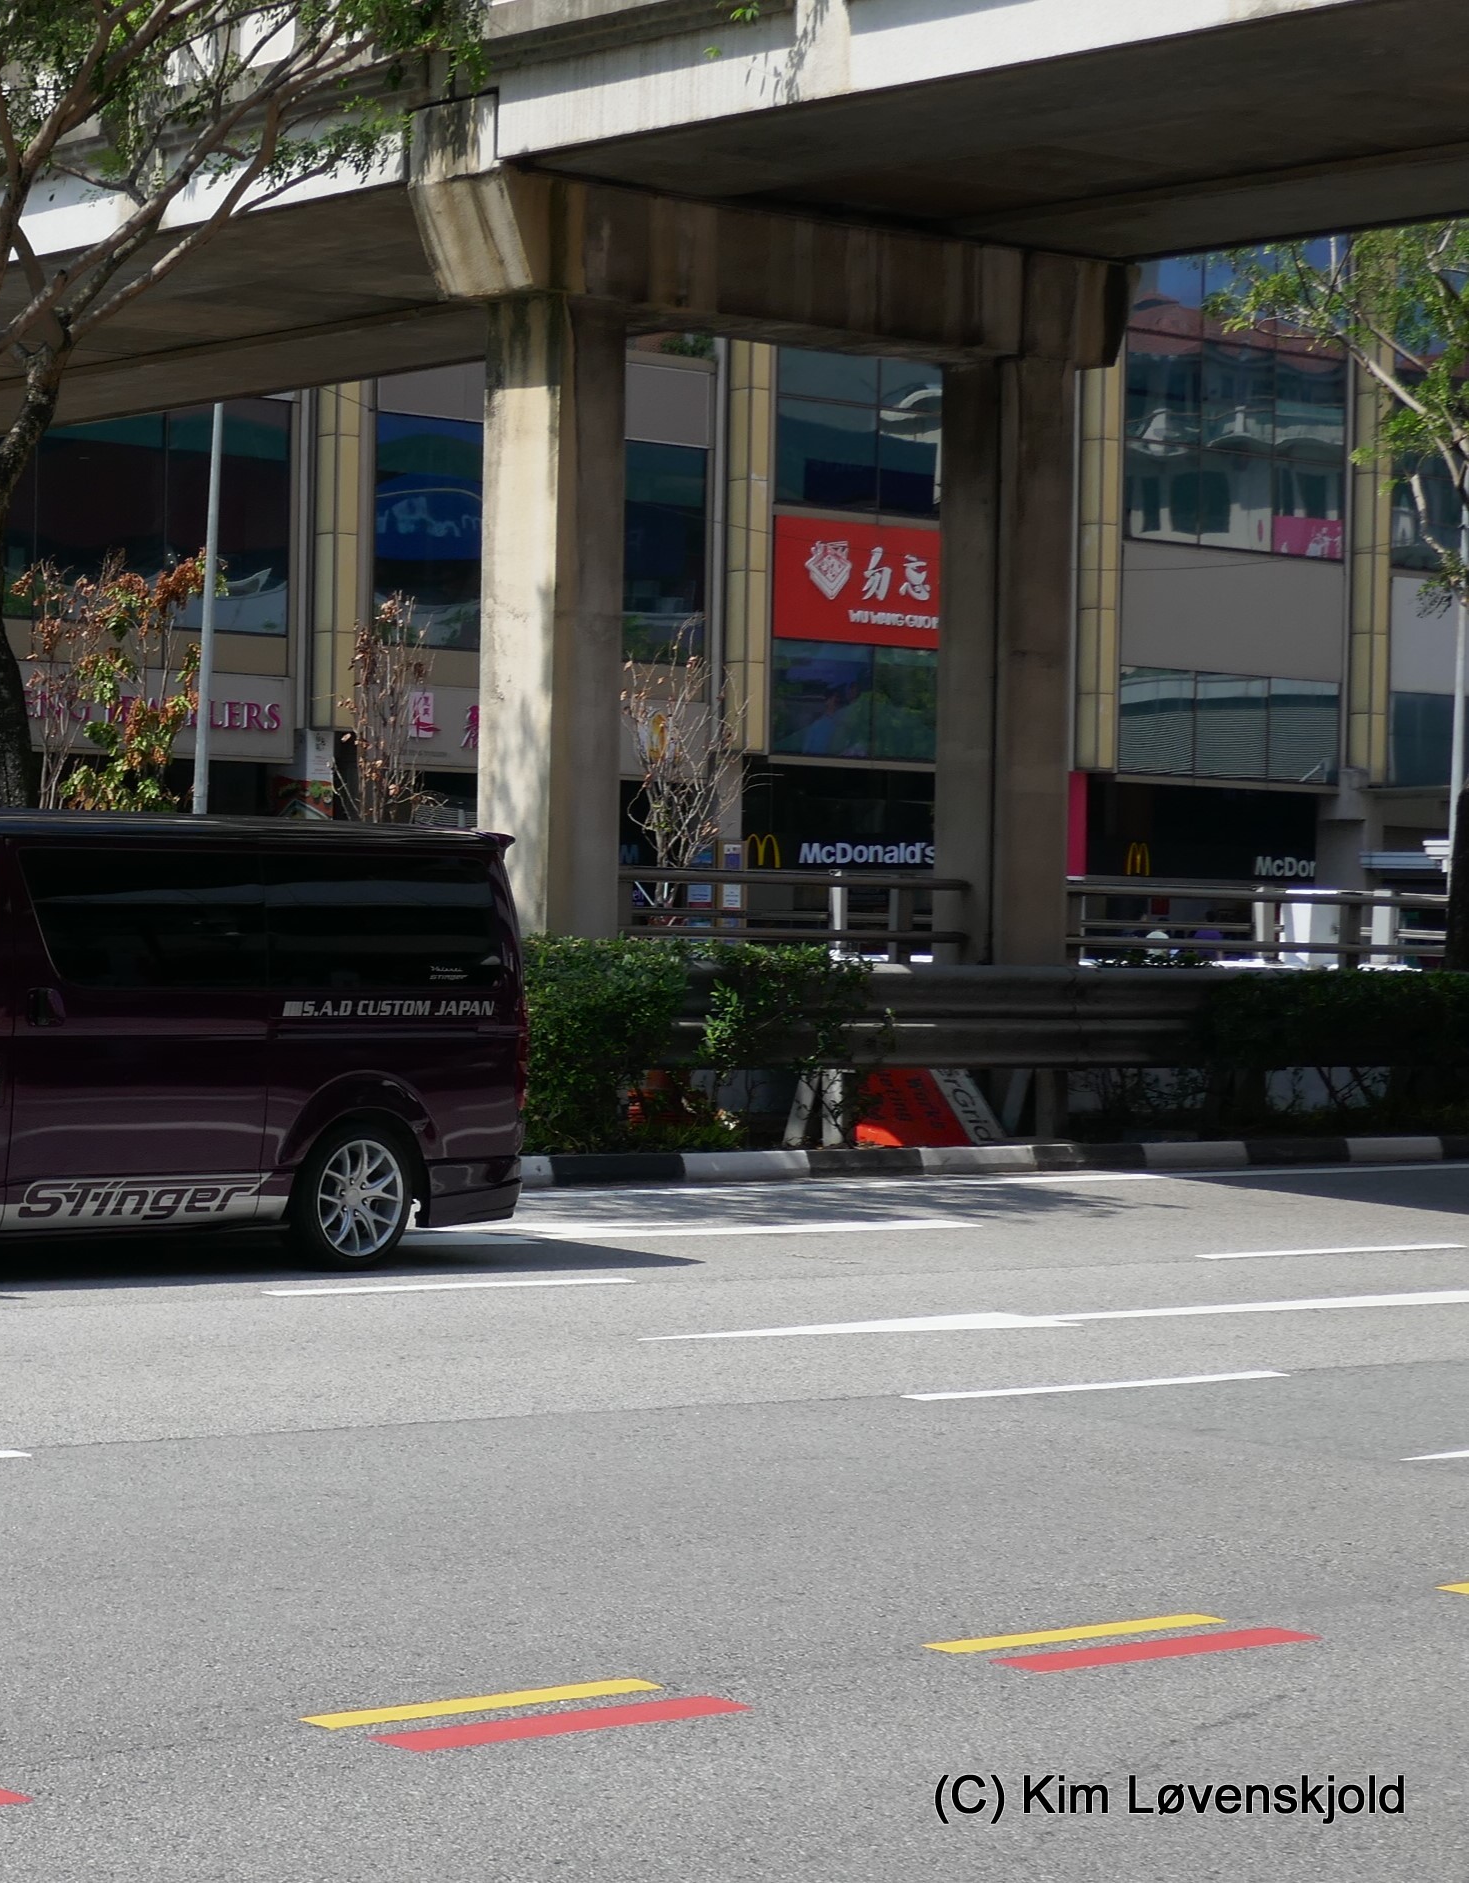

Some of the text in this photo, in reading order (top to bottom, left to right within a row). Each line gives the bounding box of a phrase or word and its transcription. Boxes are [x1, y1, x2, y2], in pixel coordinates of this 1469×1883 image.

[798, 842, 935, 864] McDonald's
[356, 1000, 431, 1016] CUSTOM
[434, 1000, 495, 1016] JAPAN
